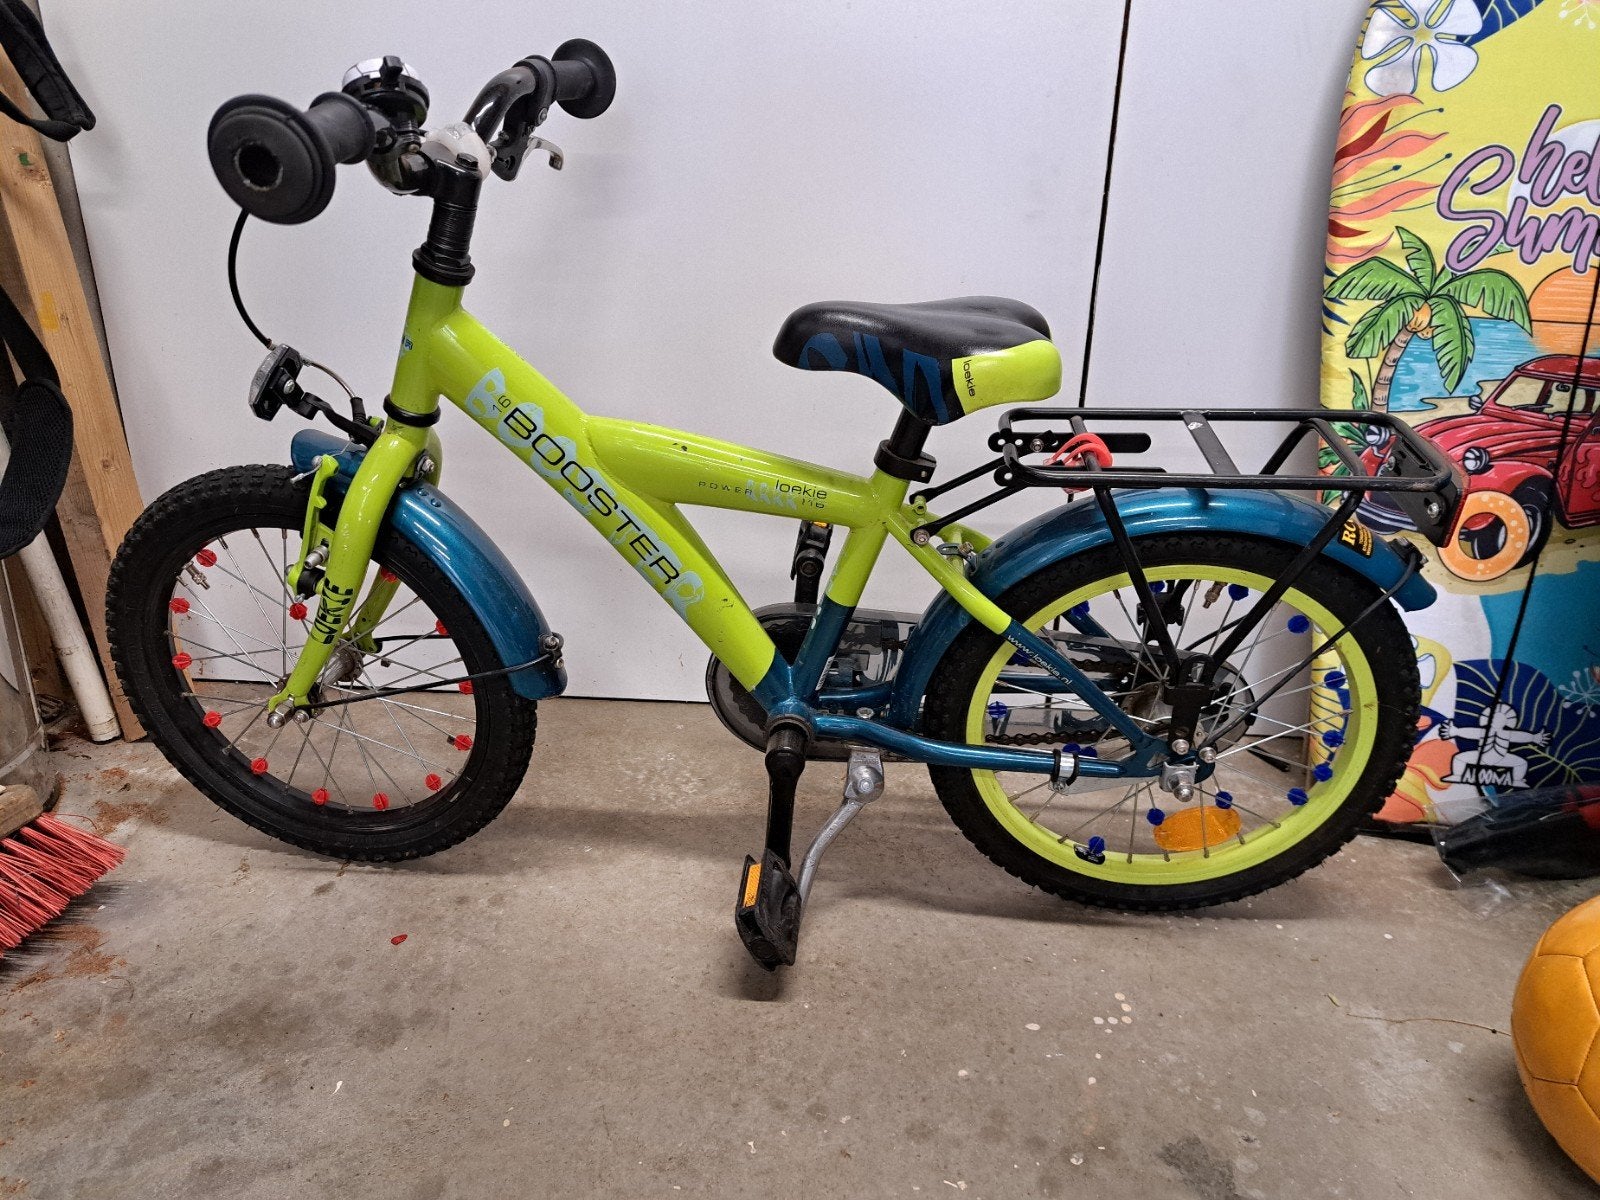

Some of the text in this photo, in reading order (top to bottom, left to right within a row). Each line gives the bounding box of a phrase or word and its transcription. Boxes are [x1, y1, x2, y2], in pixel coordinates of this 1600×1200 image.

[1436, 144, 1600, 274] Sum
[963, 359, 976, 397] loekie
[493, 395, 511, 413] 16
[503, 407, 680, 585] BOOSTER
[698, 480, 753, 496] POWER
[775, 479, 828, 500] loekie
[1007, 635, 1073, 685] www.loekie.nl
